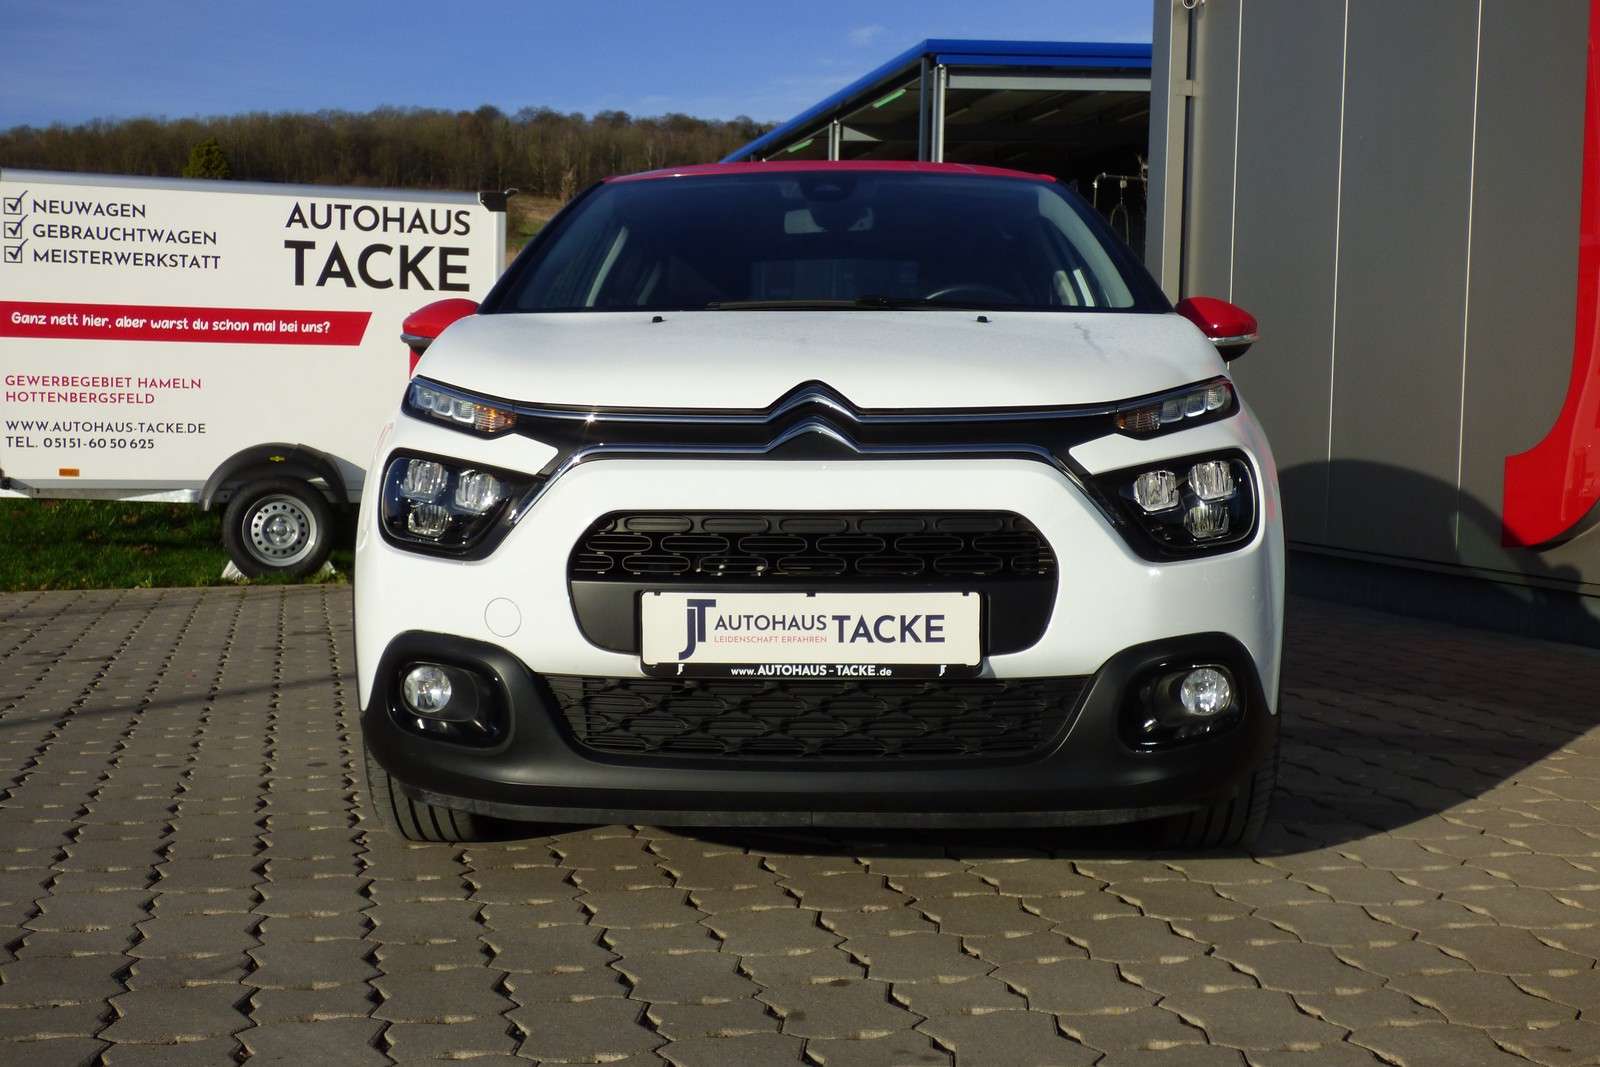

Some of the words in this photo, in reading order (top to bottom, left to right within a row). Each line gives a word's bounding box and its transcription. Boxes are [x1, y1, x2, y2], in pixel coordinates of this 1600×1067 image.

[33, 200, 146, 218] NEUWAGEN
[285, 201, 471, 236] AUTOHAUS
[33, 224, 217, 245] GEBRAUCHTWAGEN
[33, 249, 221, 269] MEISTERWERKSTATT
[284, 239, 470, 292] TACKE
[11, 311, 46, 325] Ganz
[50, 313, 79, 326] nett
[82, 314, 112, 329] hier,
[115, 315, 147, 329] aber
[150, 317, 190, 330] warst
[192, 318, 209, 330] du
[212, 319, 249, 331] schon
[253, 320, 275, 332] mal
[279, 320, 298, 333] bei
[301, 321, 331, 334] uns?
[5, 375, 132, 388] GEWERBEGEBIET
[138, 378, 202, 389] HAMELN
[5, 391, 155, 404] HOTTENBERGSFELD
[6, 420, 206, 434] WWW.AUTOHAUS-TACKE.DE
[6, 436, 38, 448] TEL.
[714, 614, 827, 631] AUTOHAUS
[831, 614, 945, 643] TACKE
[714, 635, 779, 644] LEIDENSCHAFT
[781, 635, 828, 644] ERFAHREN
